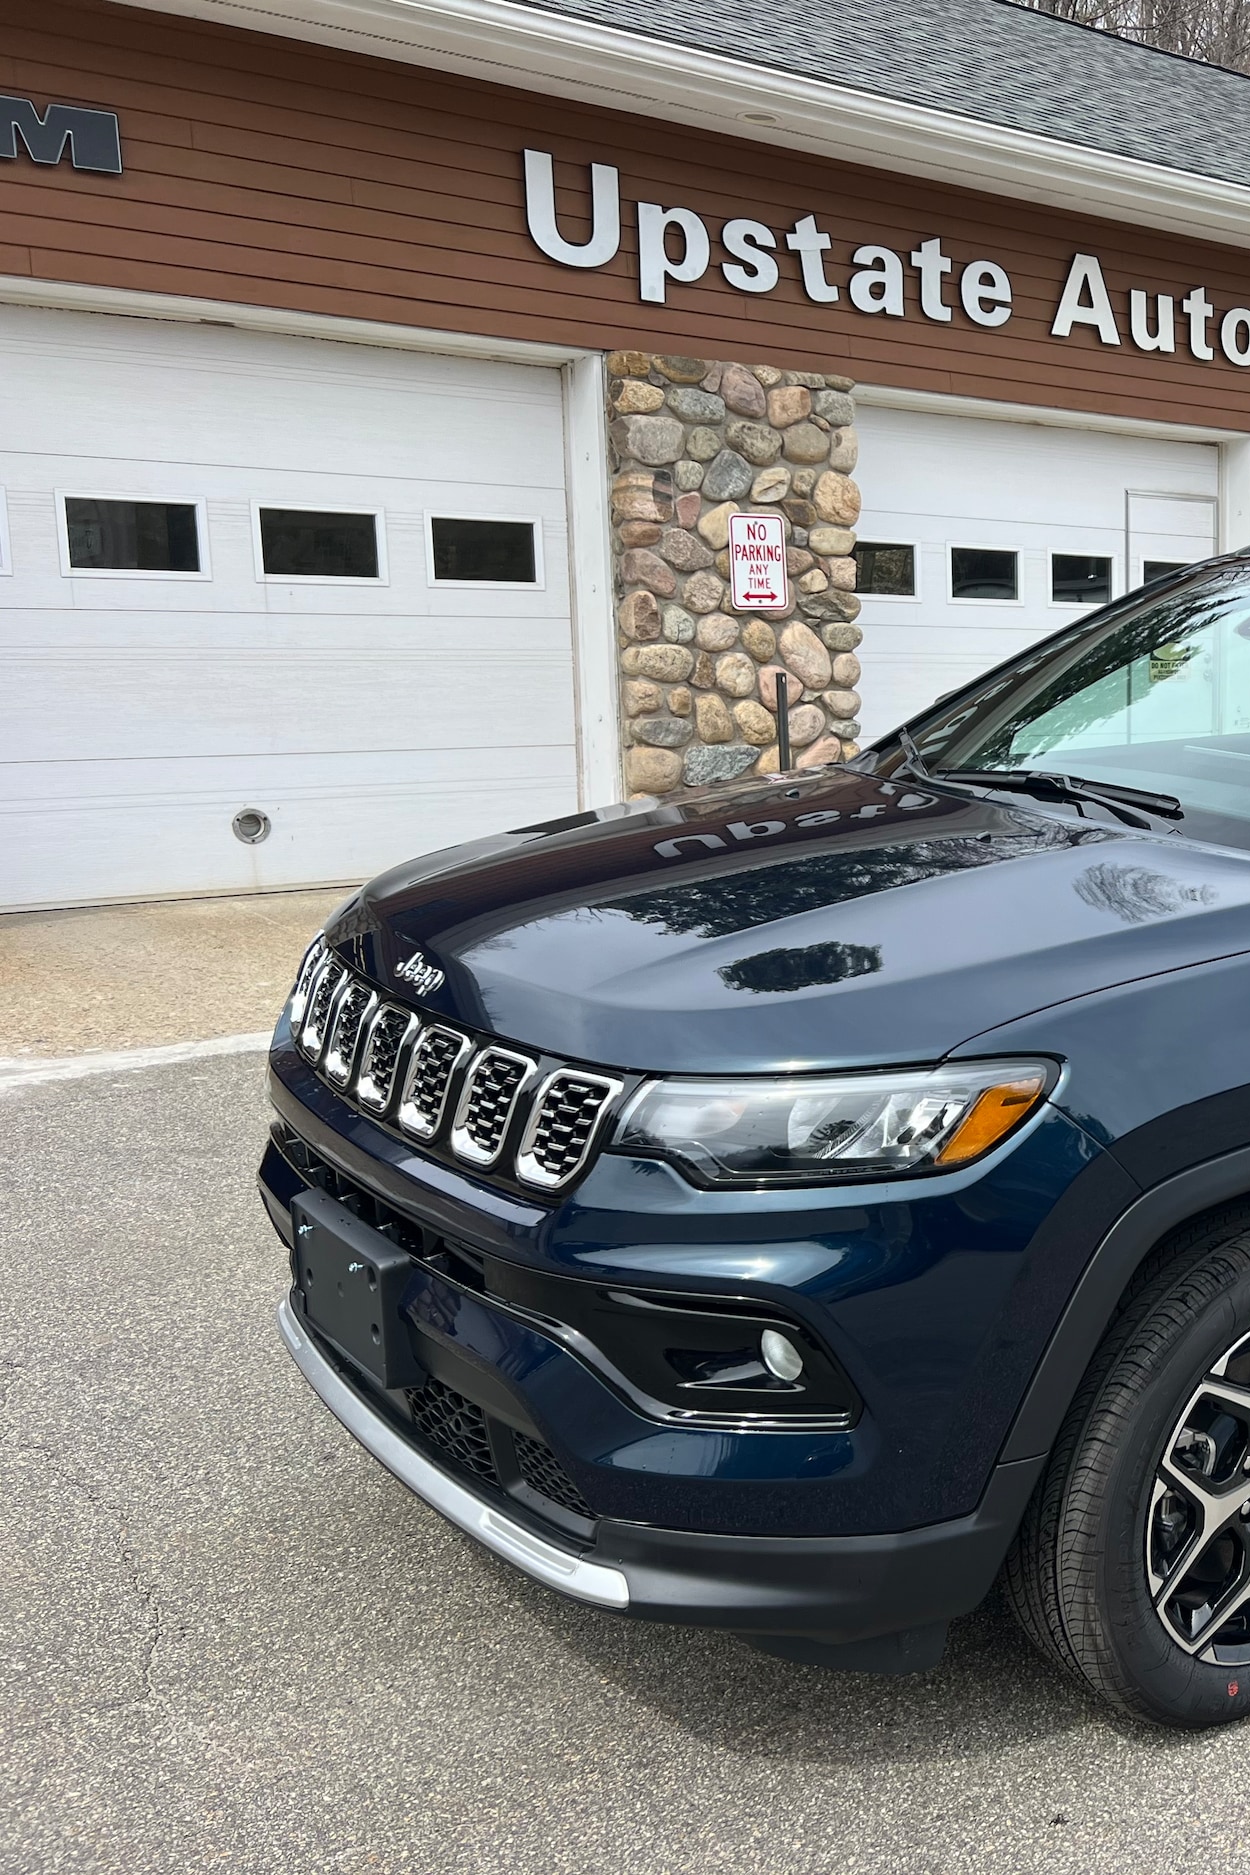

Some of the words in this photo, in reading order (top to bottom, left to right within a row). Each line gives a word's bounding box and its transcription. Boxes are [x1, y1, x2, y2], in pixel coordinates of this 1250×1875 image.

[523, 148, 1013, 328] Upstate
[746, 523, 767, 541] NO
[734, 544, 781, 562] PARKING
[748, 564, 769, 576] ANY
[747, 577, 772, 590] TIME
[393, 951, 445, 997] Jeep
